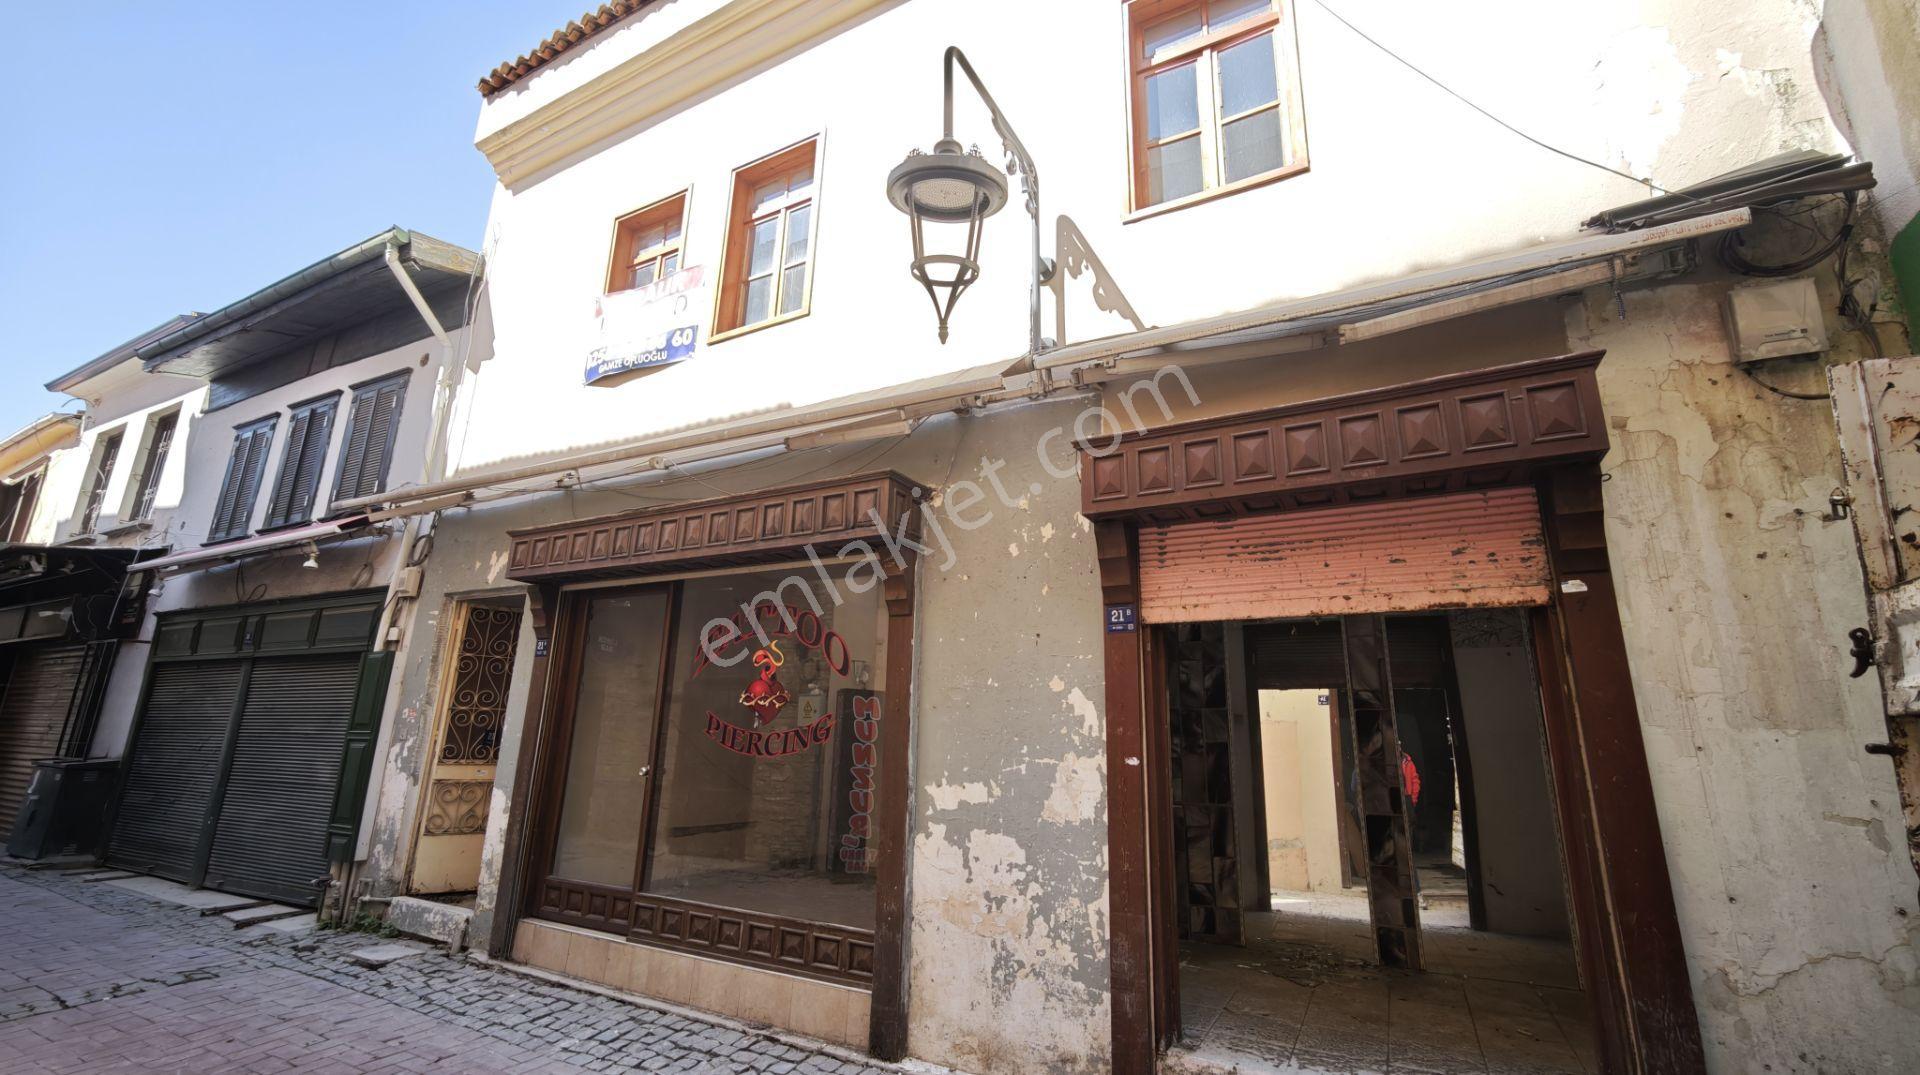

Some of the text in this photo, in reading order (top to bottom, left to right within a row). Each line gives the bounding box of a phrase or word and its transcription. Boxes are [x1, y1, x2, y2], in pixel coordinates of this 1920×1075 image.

[671, 328, 694, 347] 60
[1111, 610, 1124, 621] 21
[704, 711, 836, 759] PIERCING
